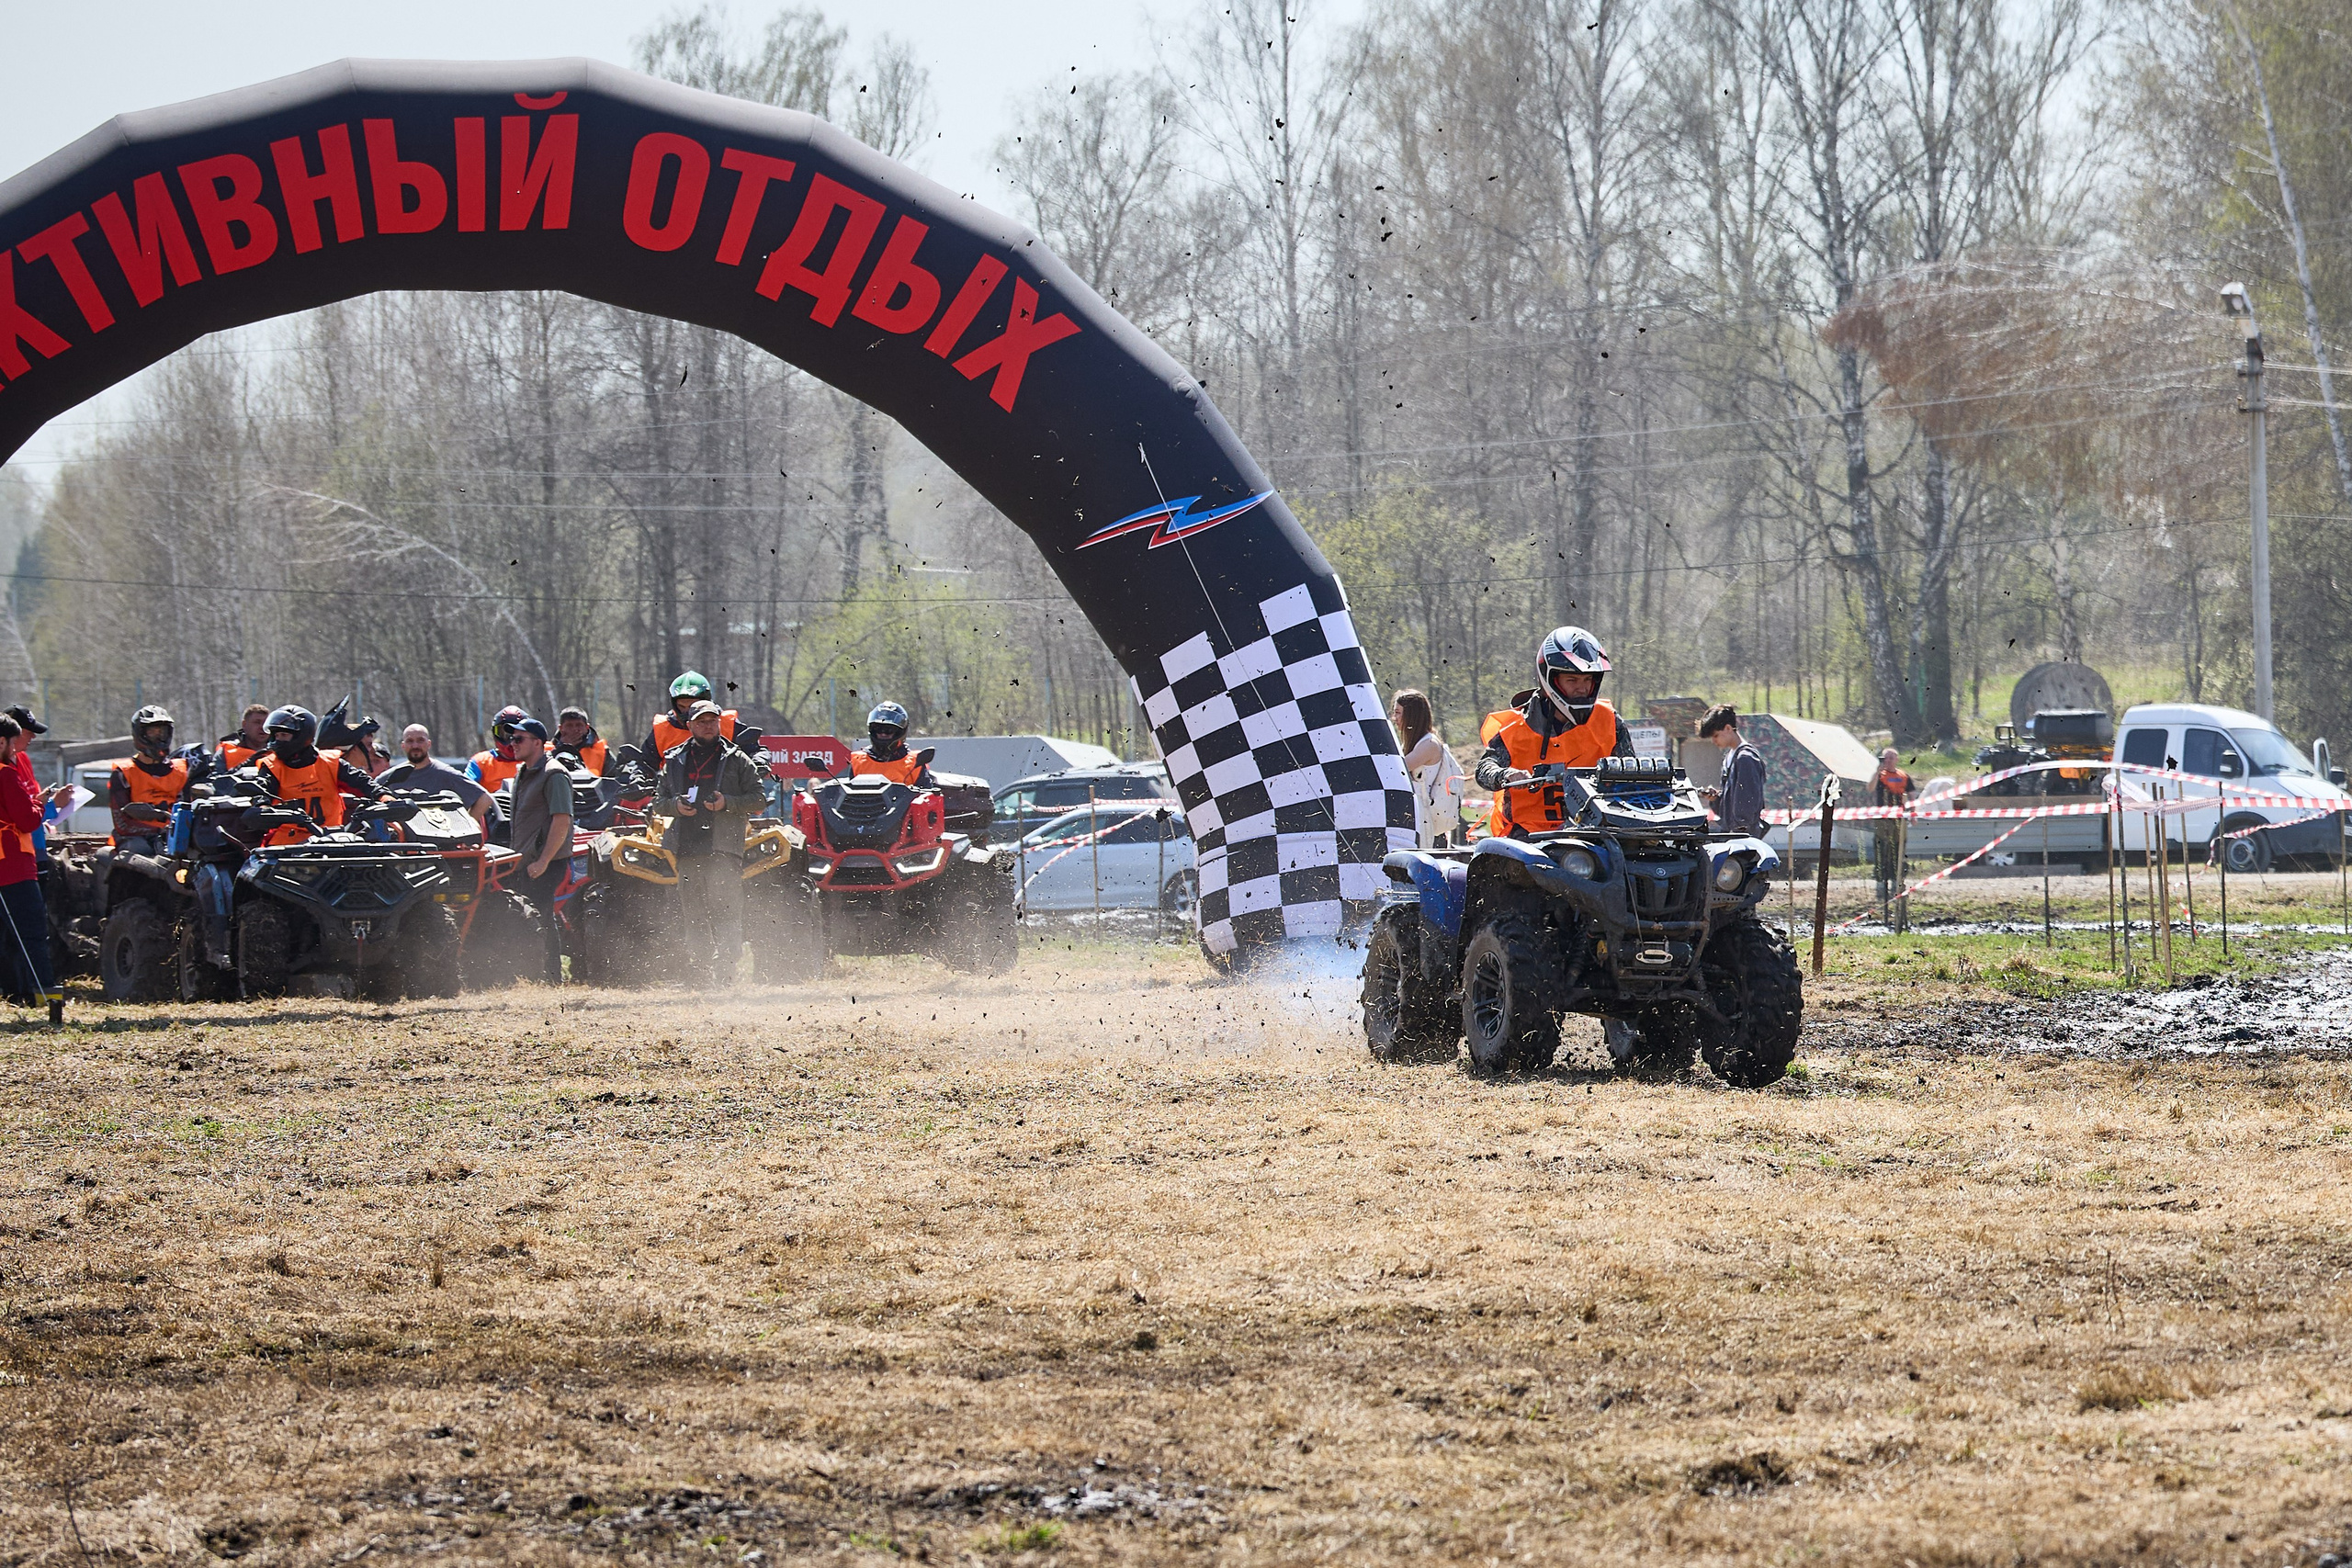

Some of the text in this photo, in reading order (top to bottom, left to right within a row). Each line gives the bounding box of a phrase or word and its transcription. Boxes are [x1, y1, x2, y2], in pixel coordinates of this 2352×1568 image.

[0, 91, 1082, 412] КТИВНЫЙ ОТДЫХ
[1629, 729, 1661, 739] ЦЕПЫ
